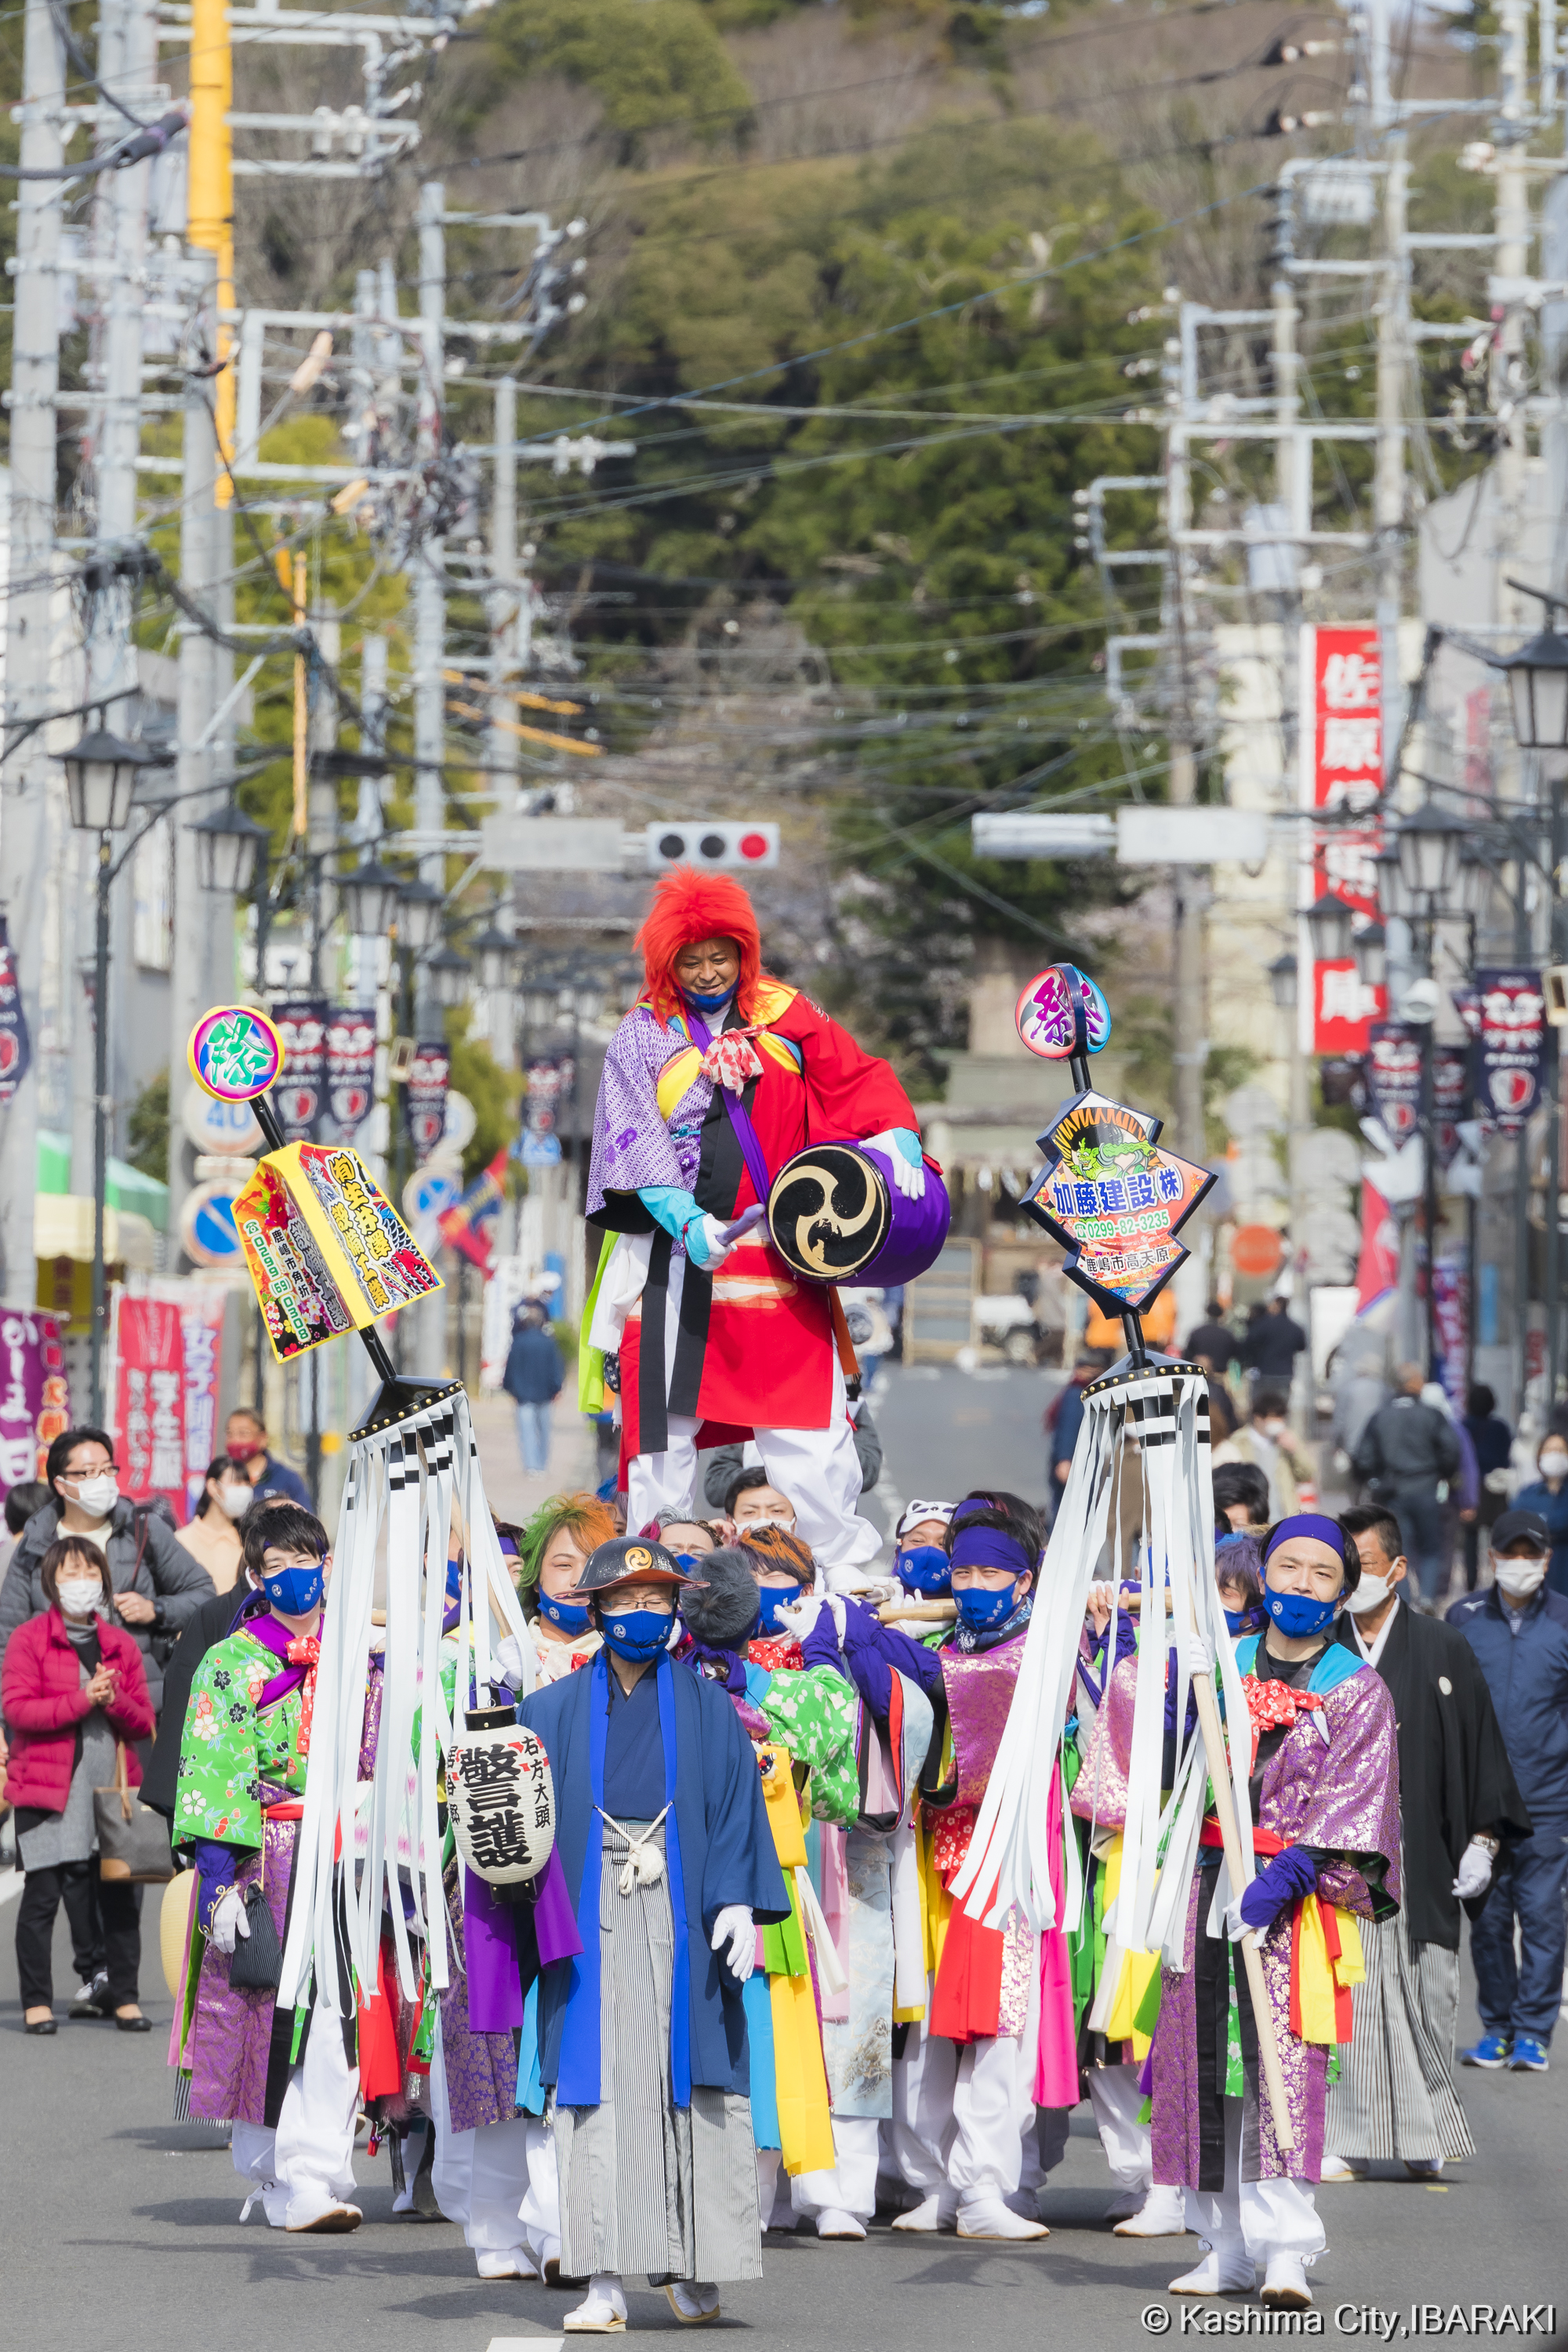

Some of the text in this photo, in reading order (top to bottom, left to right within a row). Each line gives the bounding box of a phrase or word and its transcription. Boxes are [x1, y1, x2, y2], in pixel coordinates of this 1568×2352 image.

[271, 1229, 310, 1299] 鹿嶋市角折
[331, 1201, 390, 1309] 設備工業
[1086, 1245, 1170, 1272] 鹿嶋市高天原
[1087, 1211, 1169, 1239] 0299-82-3235
[459, 1742, 533, 1870] 警護
[521, 1736, 551, 1829] 右方大頭
